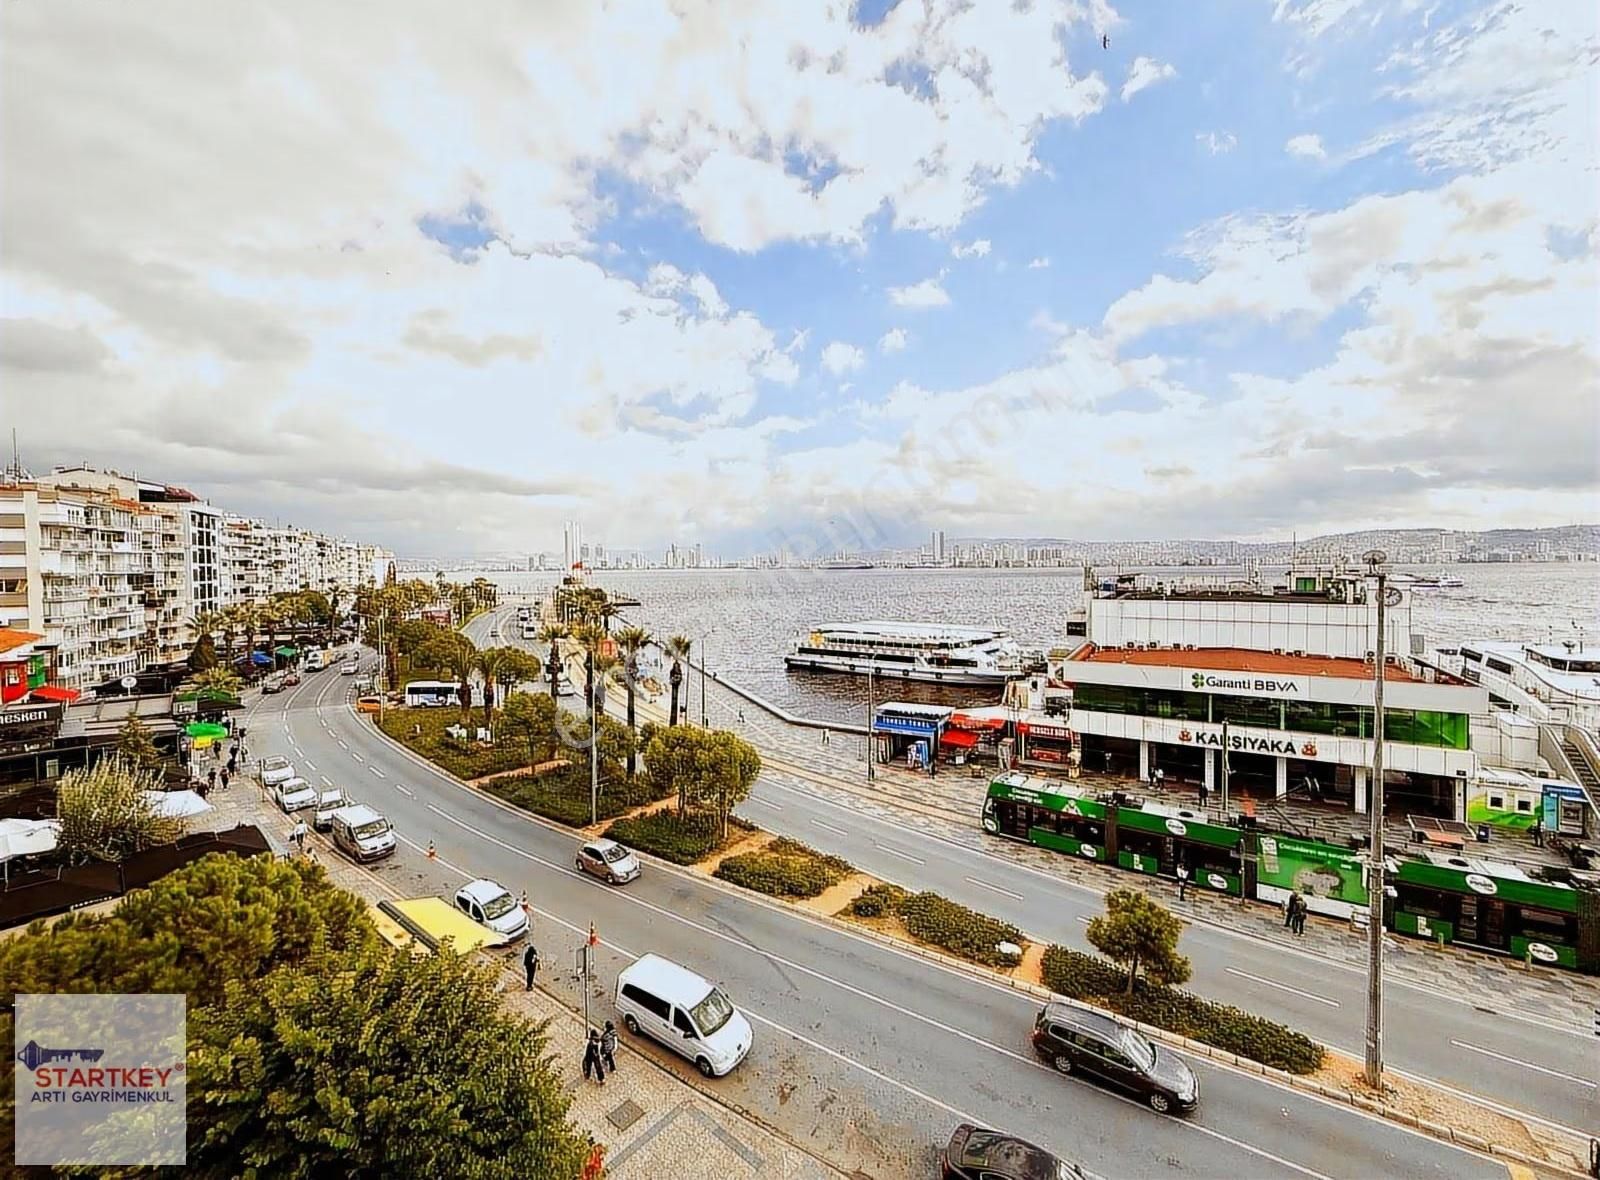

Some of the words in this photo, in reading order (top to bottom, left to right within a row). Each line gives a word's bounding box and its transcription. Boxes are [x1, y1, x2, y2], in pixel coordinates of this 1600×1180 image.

[1206, 676, 1250, 689] Garanti
[1254, 680, 1298, 692] BBVA
[1195, 731, 1296, 754] KARŞIYAKA
